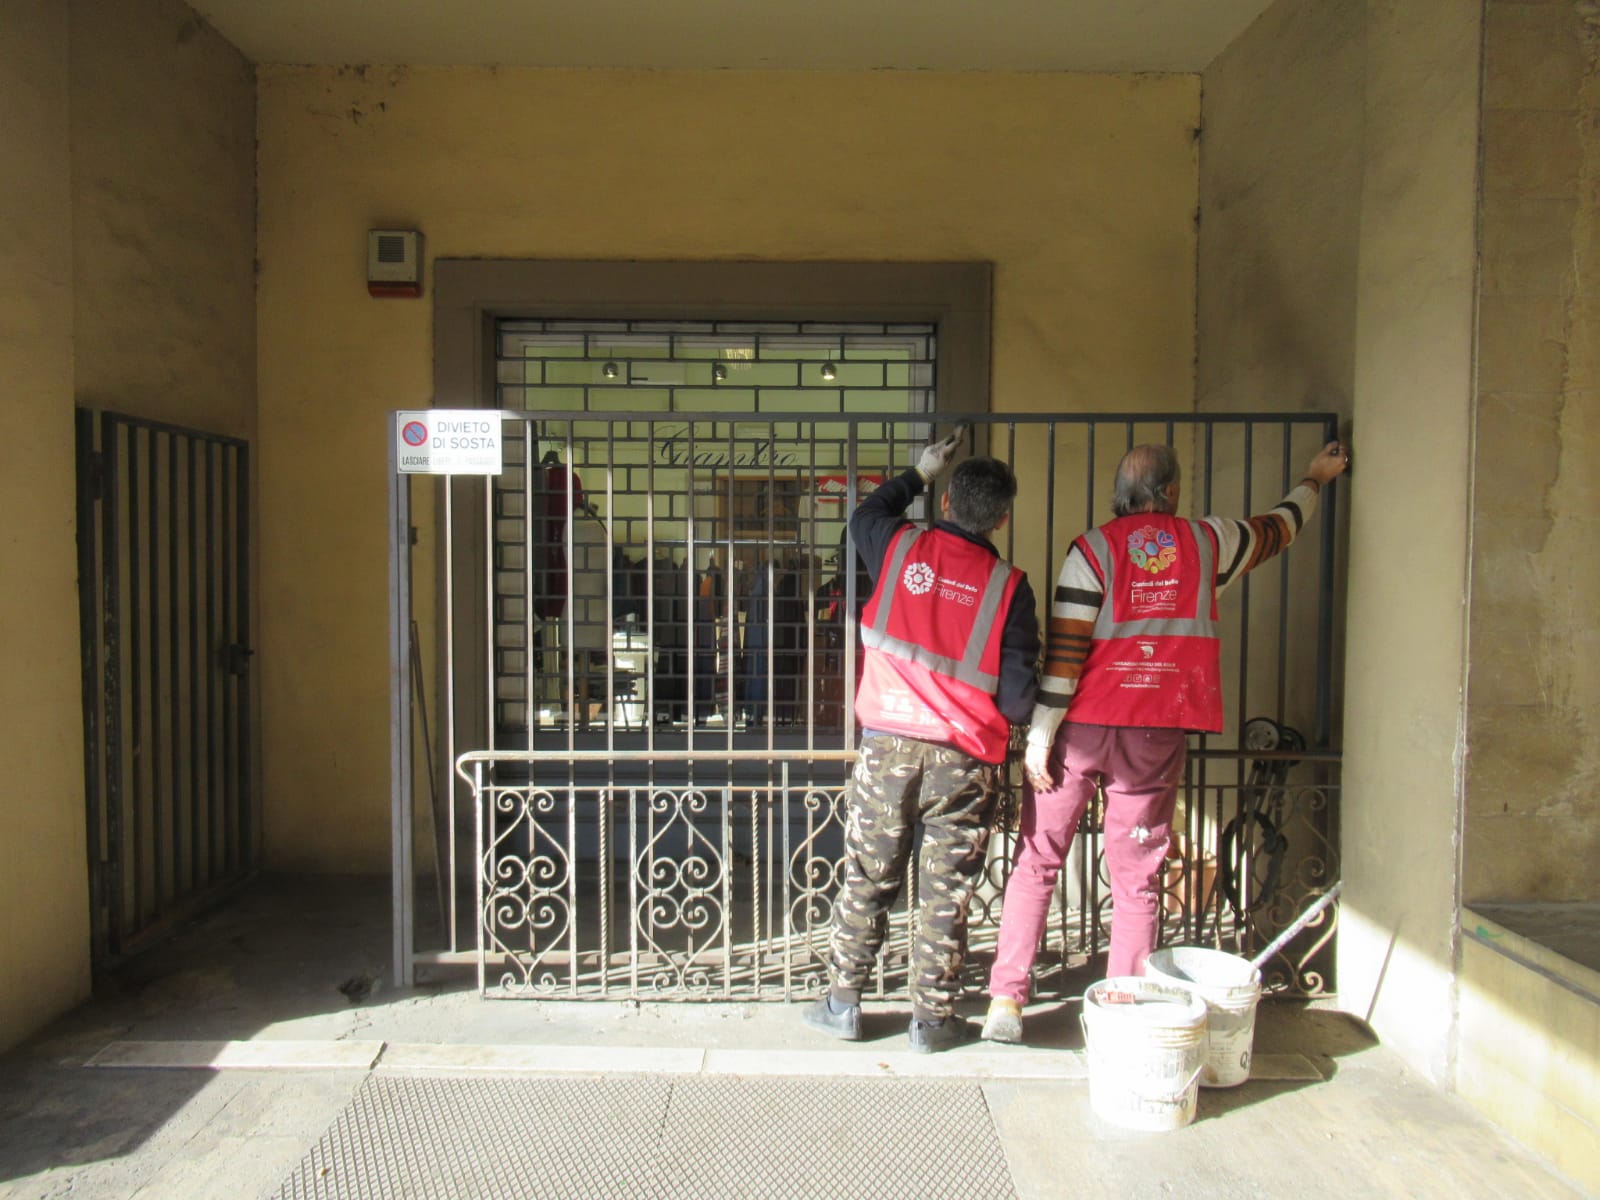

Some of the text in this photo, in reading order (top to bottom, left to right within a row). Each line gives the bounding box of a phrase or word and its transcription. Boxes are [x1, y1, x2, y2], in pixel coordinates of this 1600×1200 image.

[437, 421, 490, 433] DIVIETO
[432, 437, 496, 449] DI SOSTA
[402, 456, 430, 466] LASCIARE
[933, 583, 975, 607] Firenze
[1131, 589, 1177, 604] Firenze
